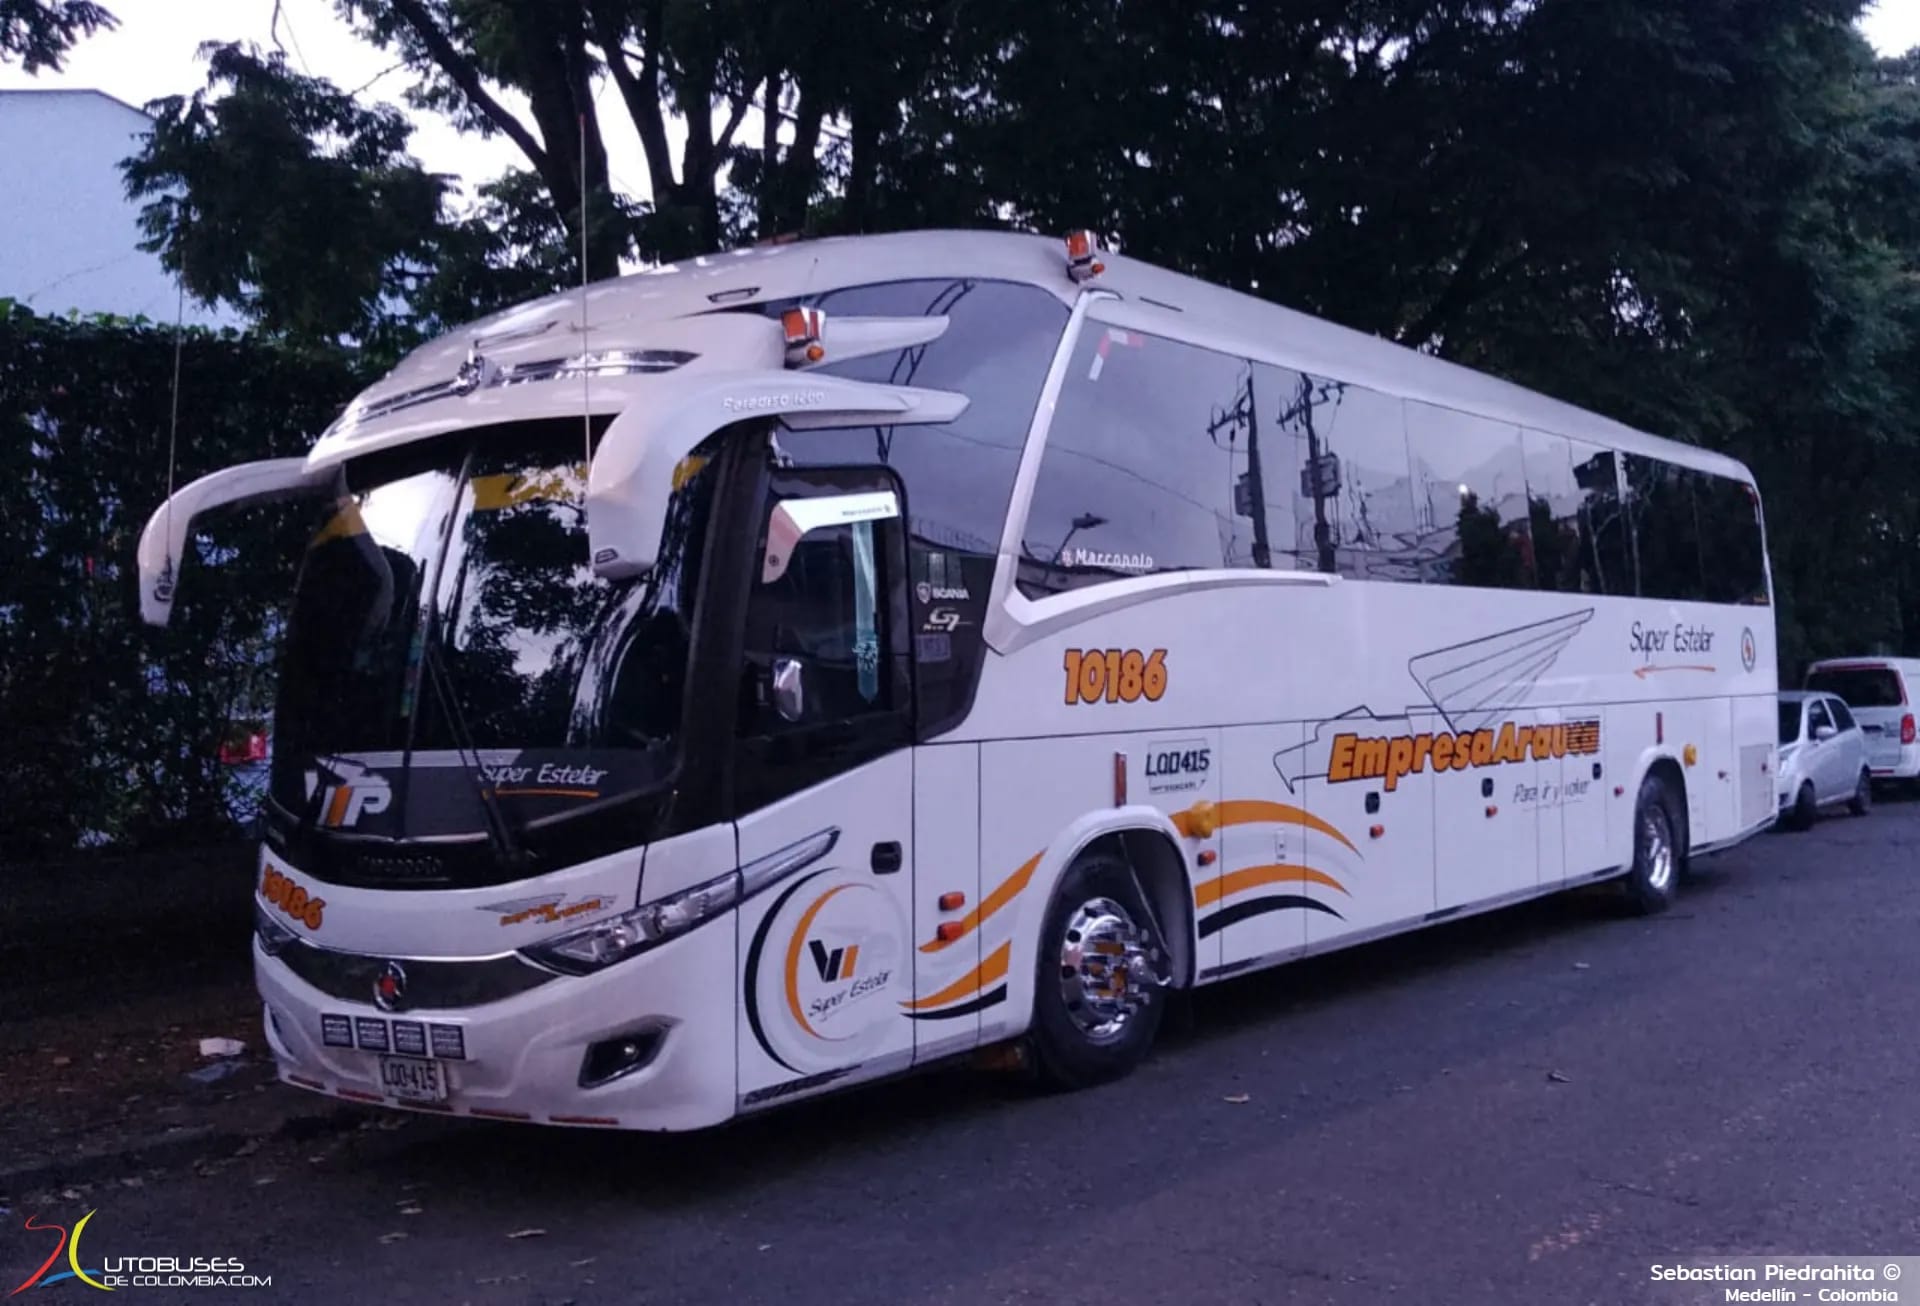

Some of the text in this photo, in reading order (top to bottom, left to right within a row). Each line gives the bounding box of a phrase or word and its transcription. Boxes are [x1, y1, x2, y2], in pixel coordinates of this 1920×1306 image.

[1075, 548, 1153, 568] Marcopolo
[932, 586, 970, 600] SCANIA
[1630, 620, 1715, 662] Super Estelar
[1064, 648, 1168, 705] 10186
[477, 762, 609, 788] Super Estelar
